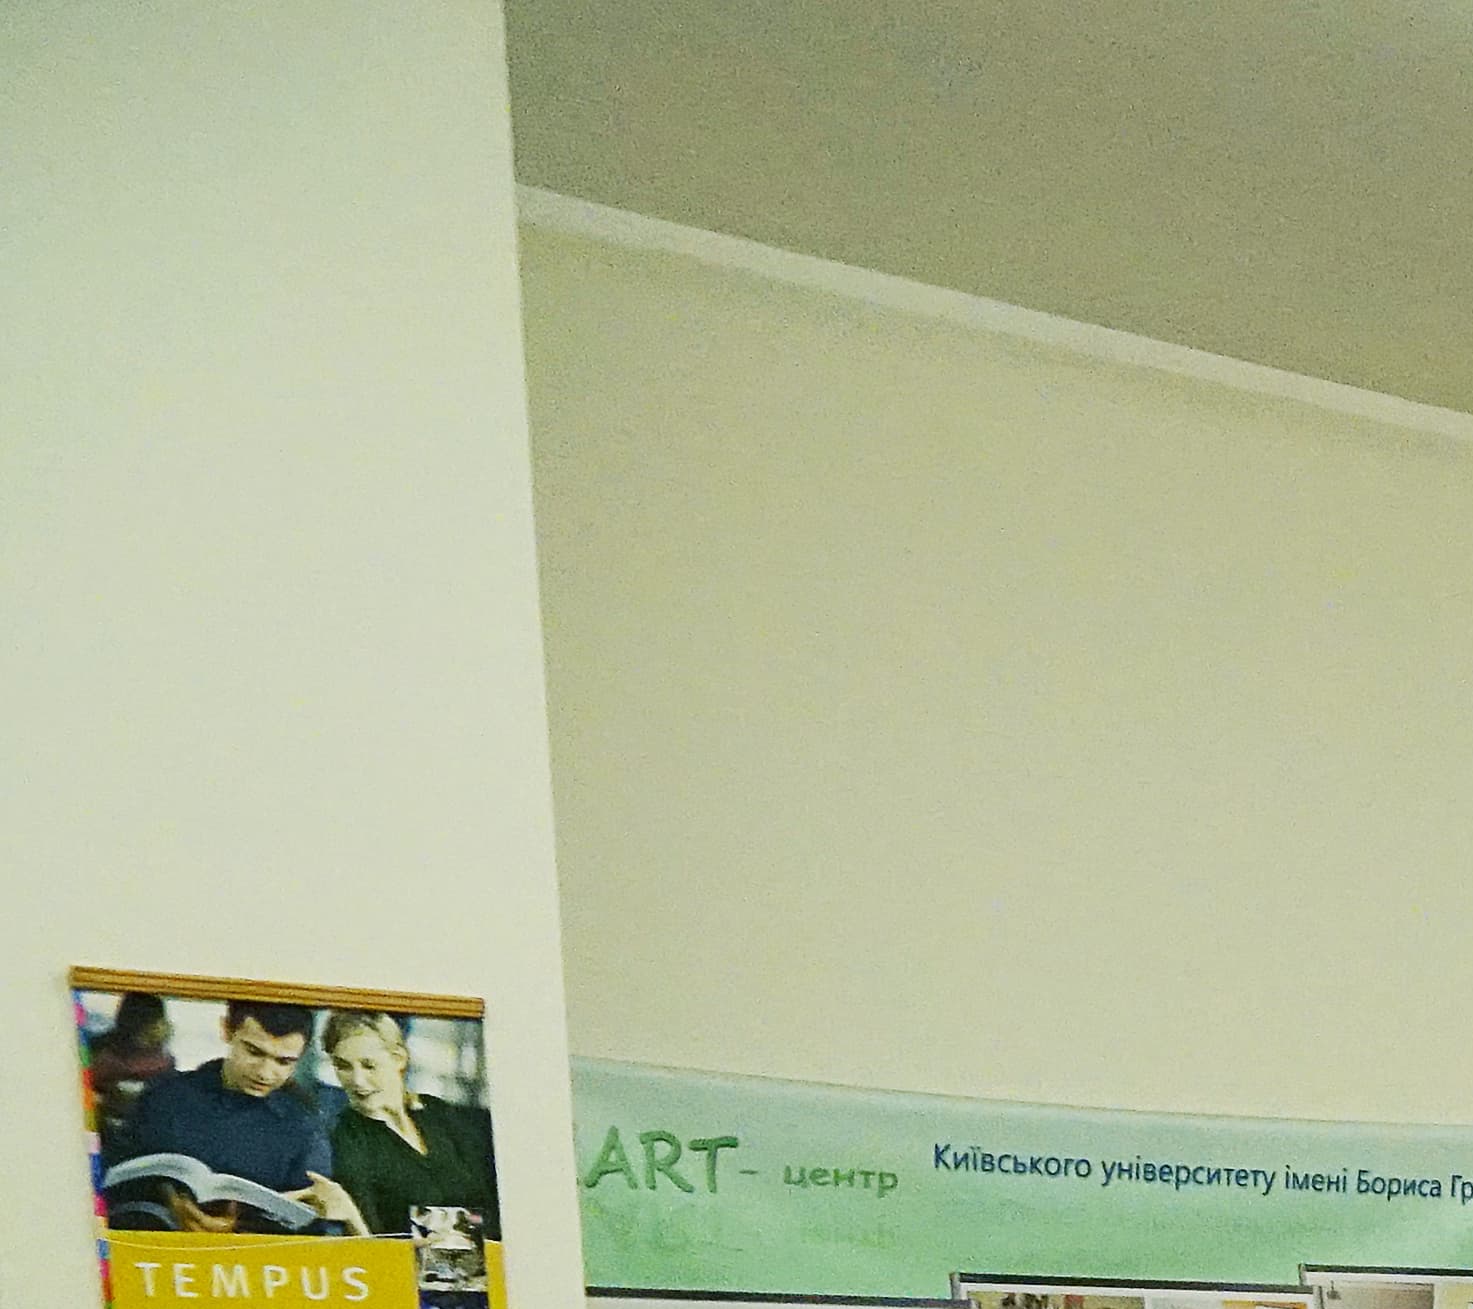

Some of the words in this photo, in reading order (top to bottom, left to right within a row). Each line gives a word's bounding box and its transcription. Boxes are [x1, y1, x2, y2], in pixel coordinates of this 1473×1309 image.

[583, 1125, 758, 1194] ART-
[783, 1162, 900, 1198] центр
[933, 1142, 1093, 1180] Київського
[1101, 1156, 1276, 1195] університету
[1284, 1164, 1349, 1195] імені
[1356, 1169, 1442, 1203] Бориса
[134, 1262, 370, 1302] TEMPUS
